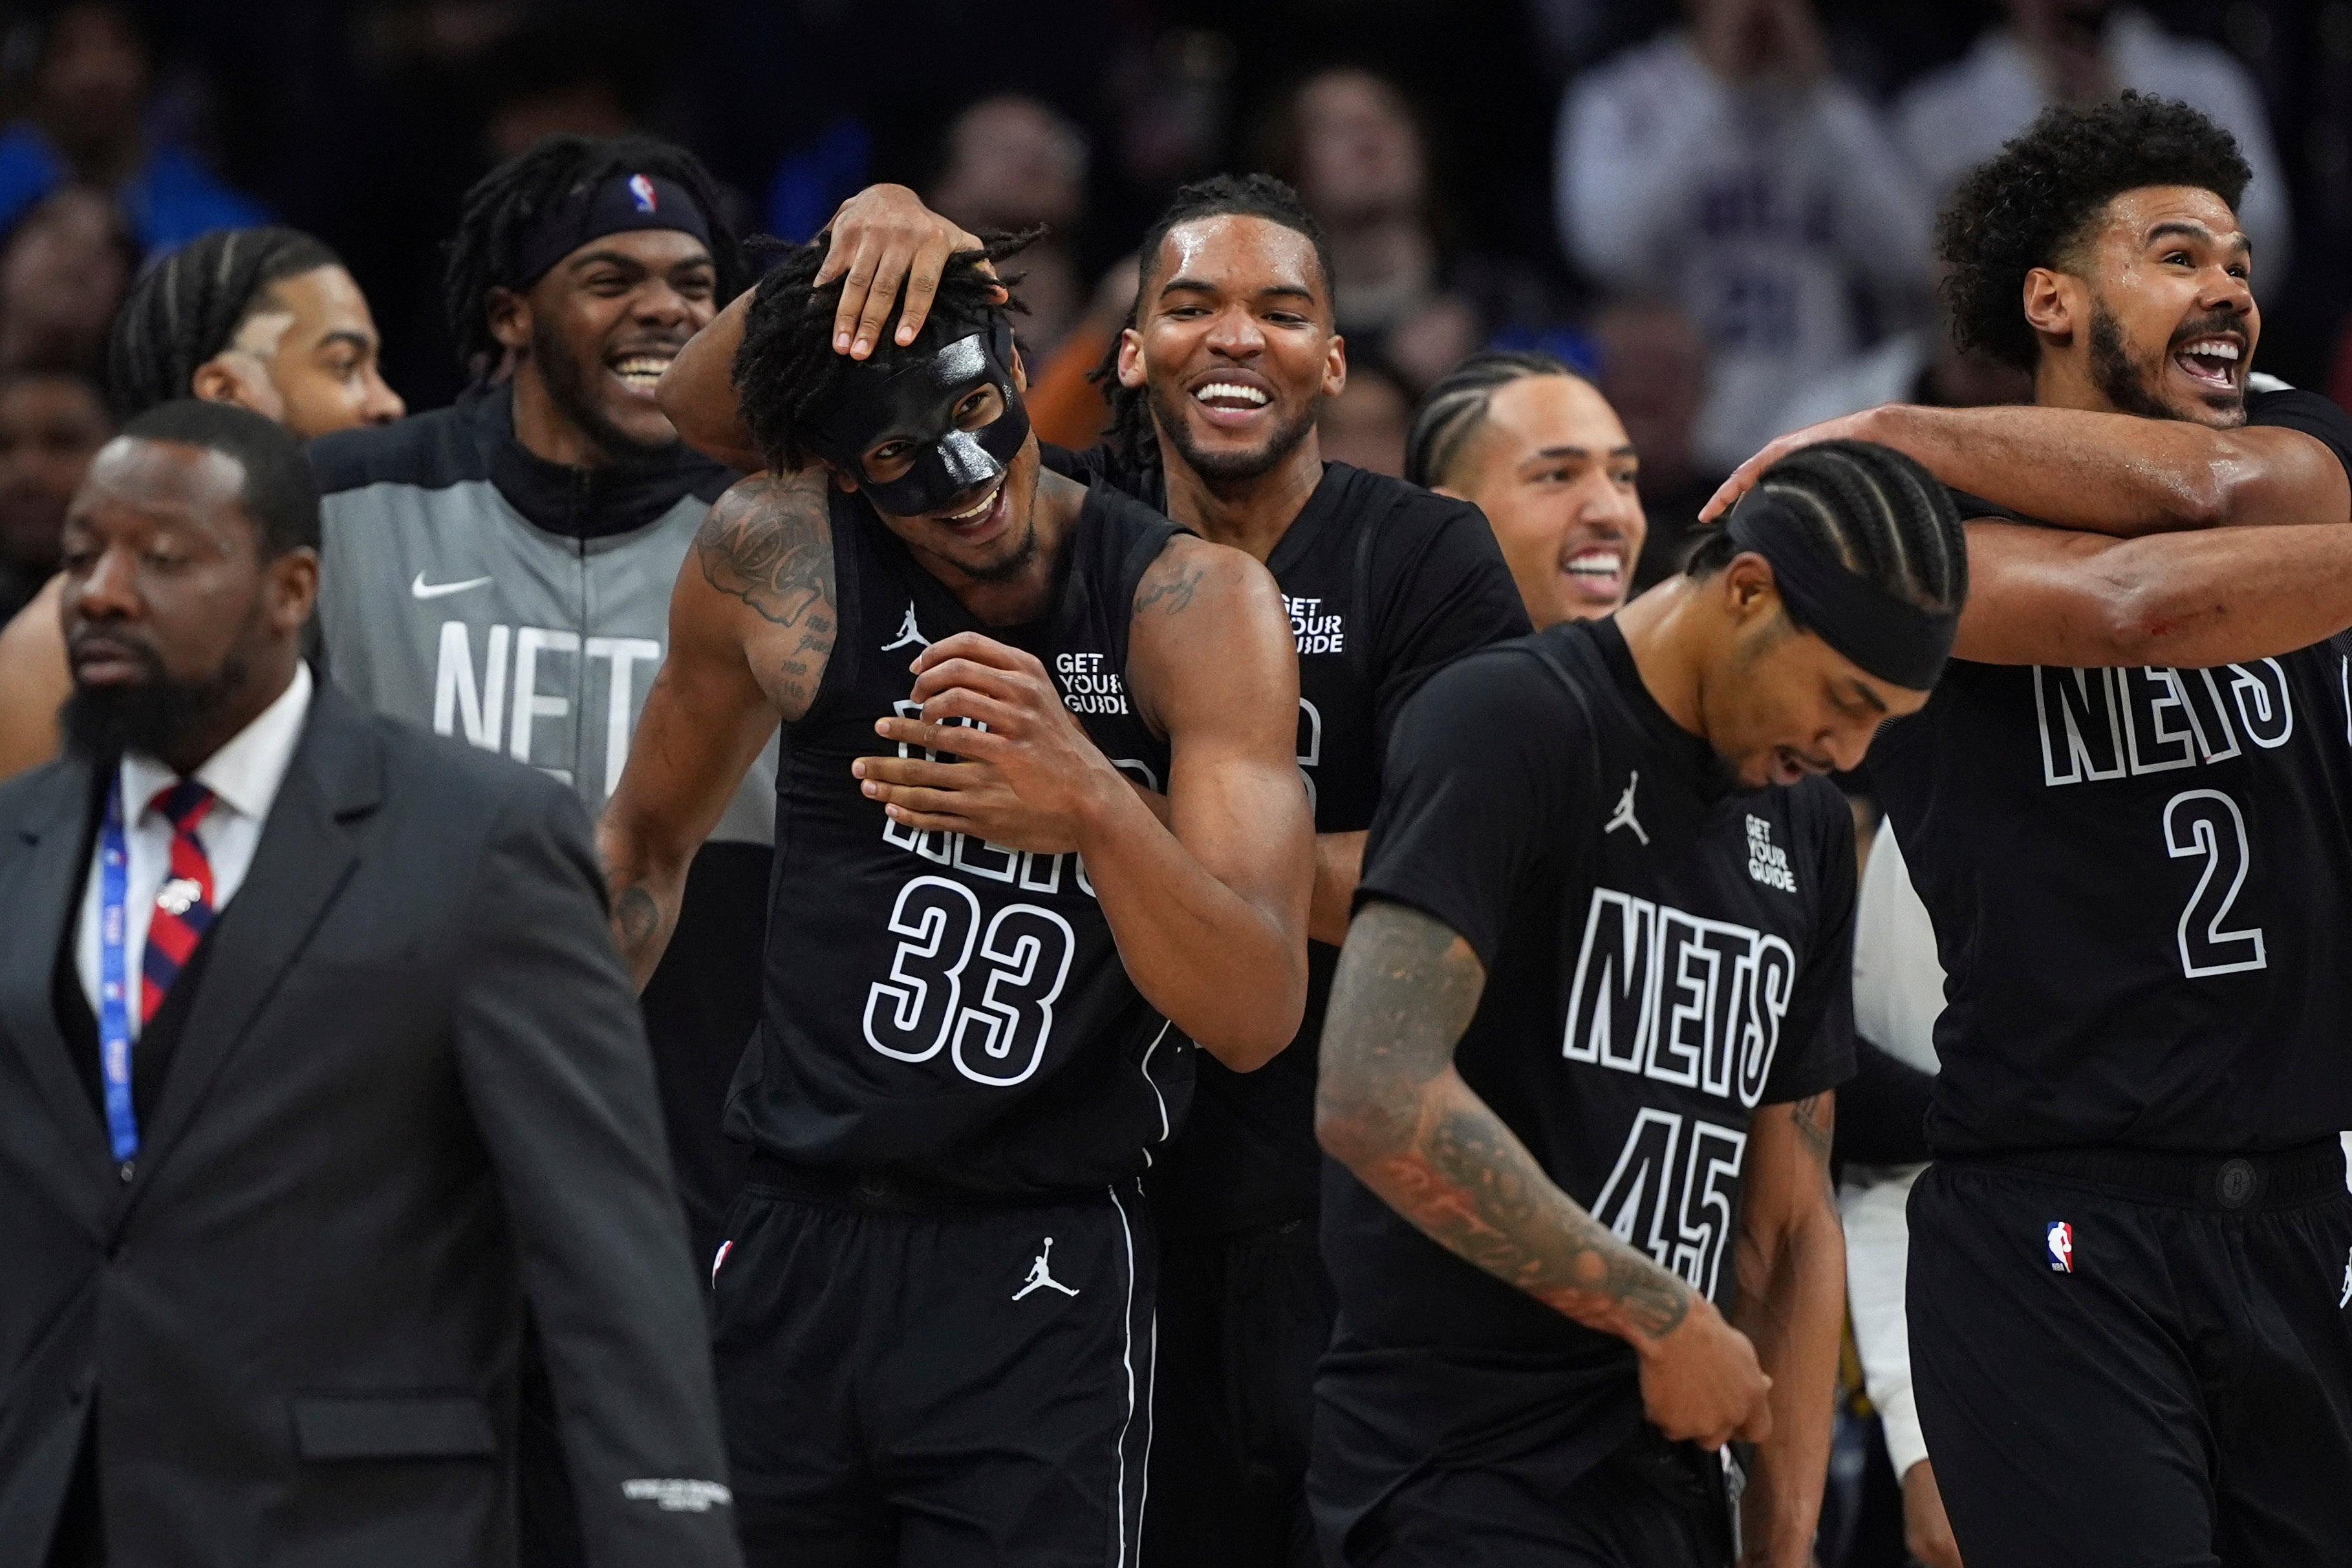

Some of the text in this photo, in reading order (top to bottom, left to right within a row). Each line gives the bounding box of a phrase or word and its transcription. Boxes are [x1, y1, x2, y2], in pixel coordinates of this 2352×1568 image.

[1290, 616, 1342, 636] OUR
[1056, 653, 1104, 673] GET
[1745, 813, 1771, 843] GET
[1747, 835, 1789, 871] YOUR
[1749, 858, 1797, 893] GUIDE
[2163, 789, 2267, 978] 2
[863, 875, 1075, 1086] 33
[1562, 886, 1796, 1109] NETS
[1590, 1106, 1747, 1304] 45
